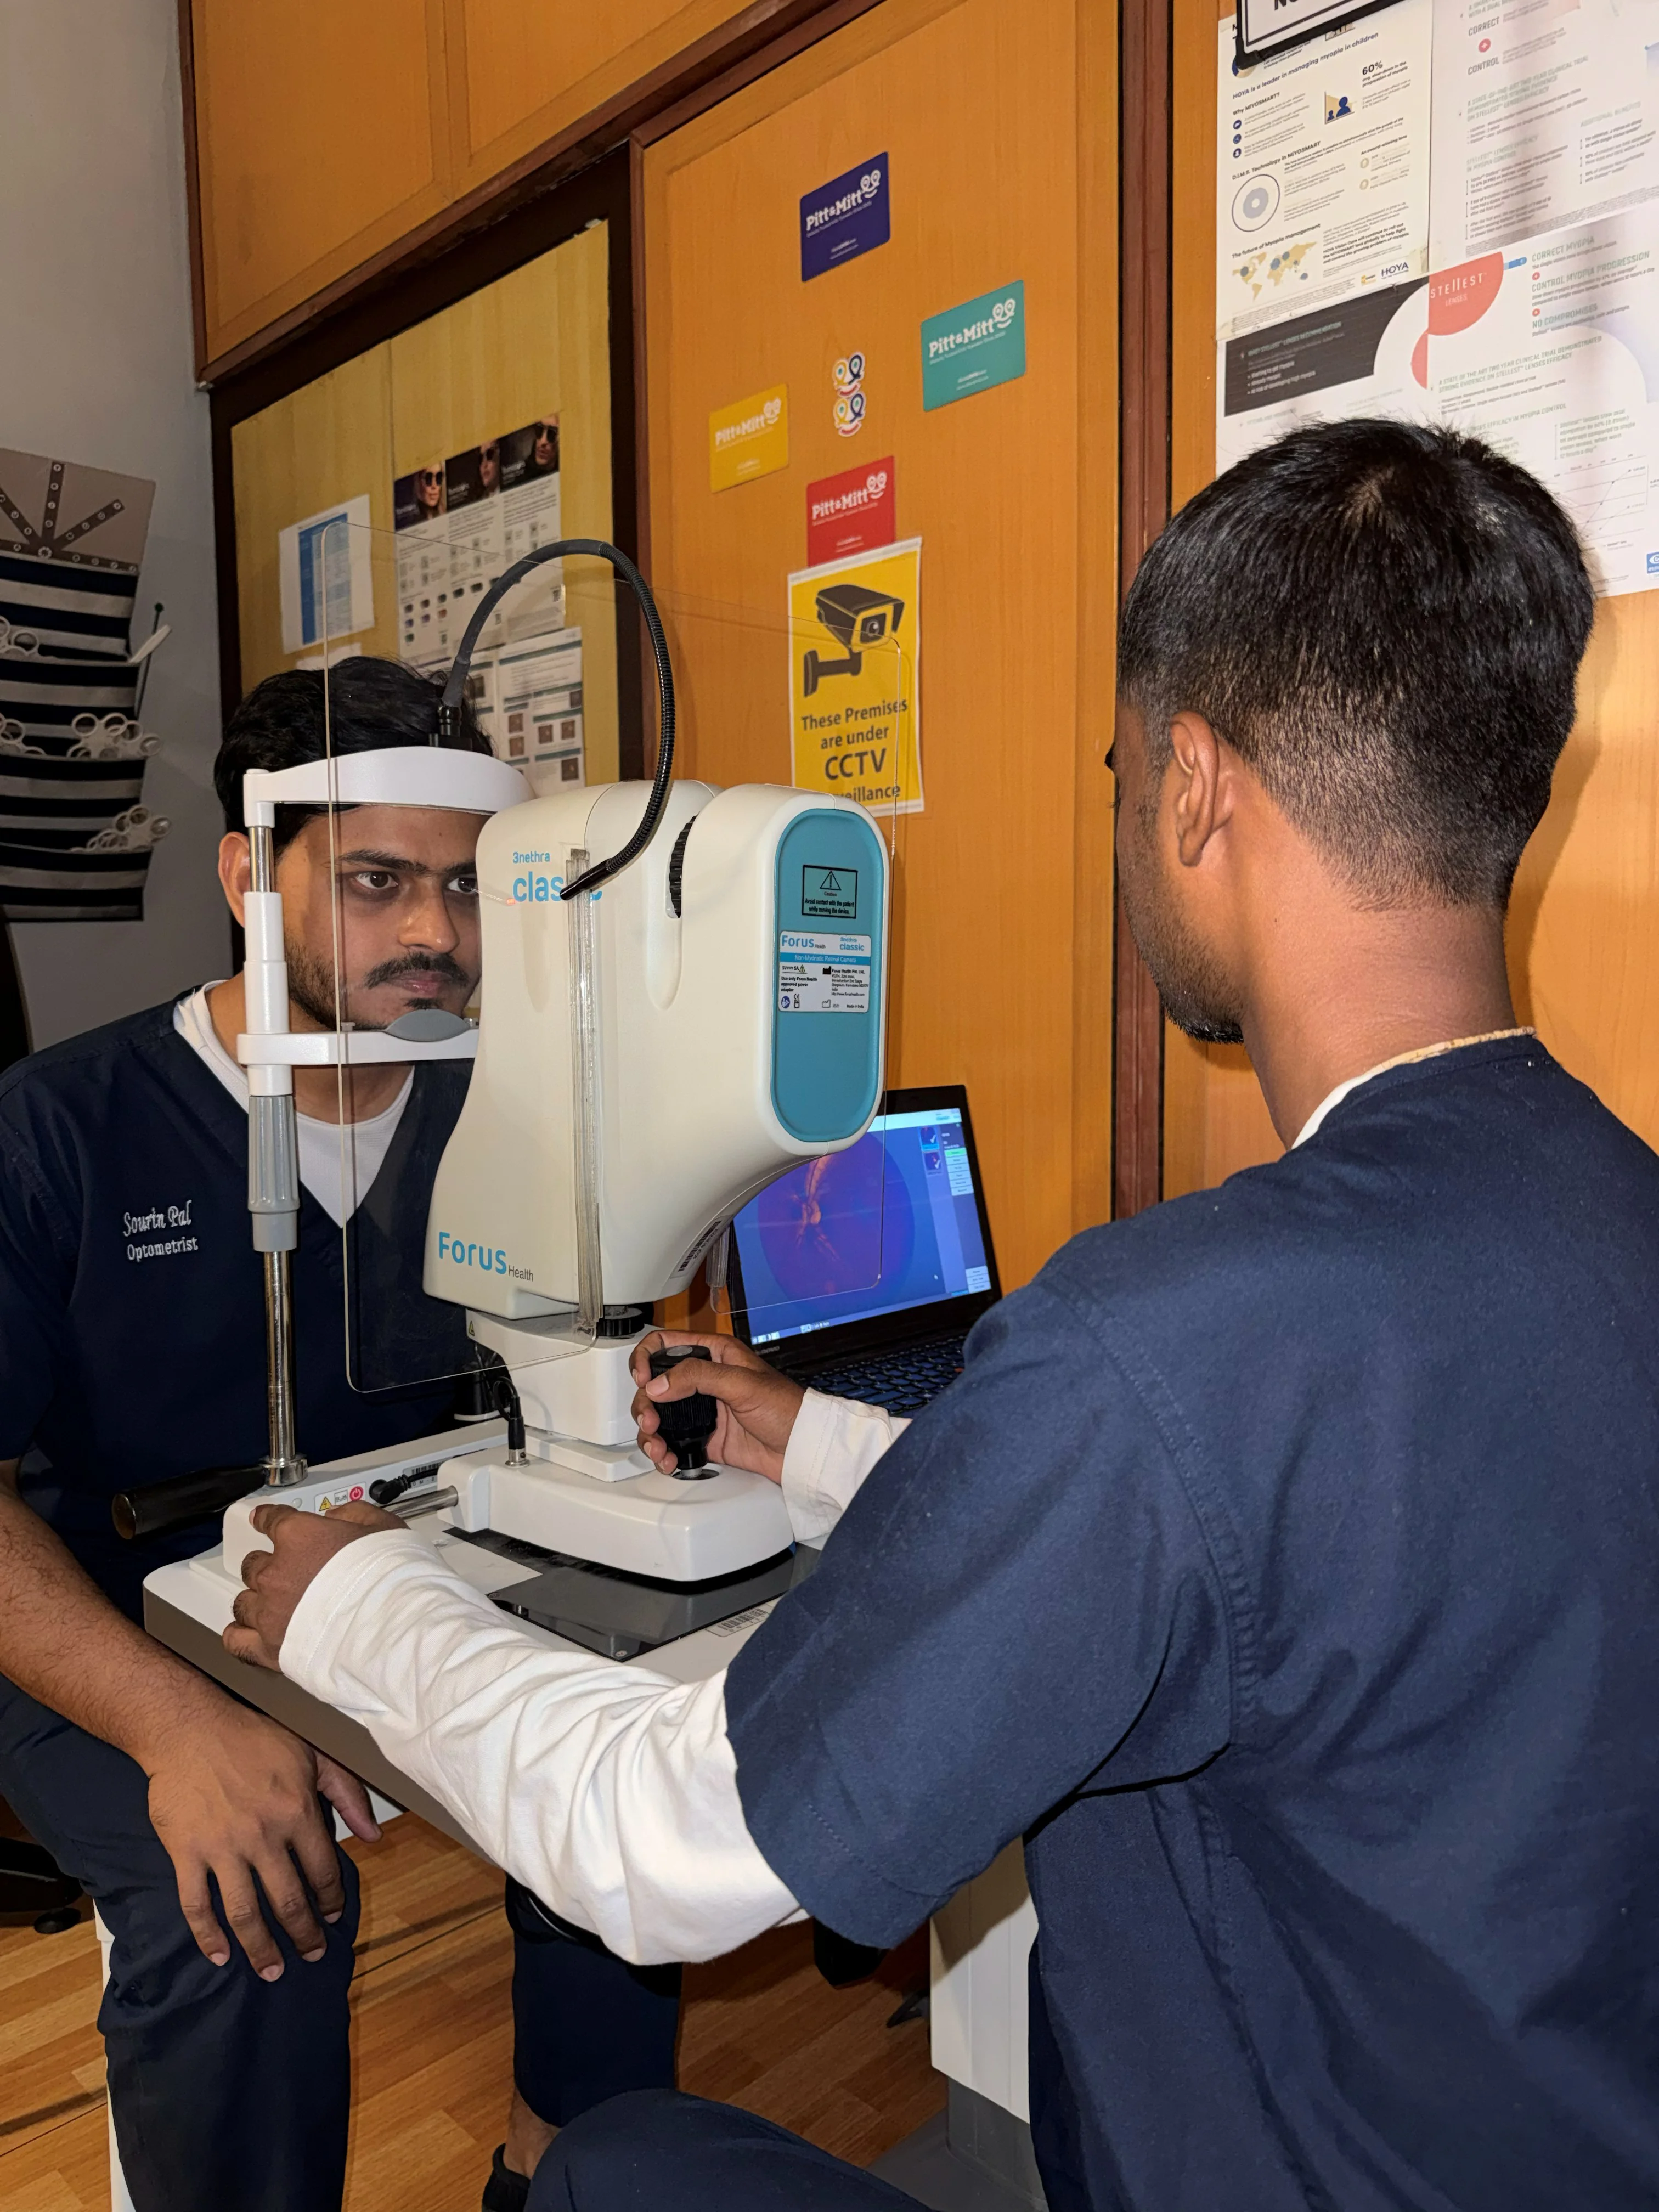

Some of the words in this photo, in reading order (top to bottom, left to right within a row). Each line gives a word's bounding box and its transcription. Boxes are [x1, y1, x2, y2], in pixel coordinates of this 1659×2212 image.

[1468, 16, 1499, 36] CORRECT
[1233, 88, 1249, 99] HOYA
[1262, 75, 1280, 87] leader
[1288, 58, 1318, 75] managing
[1319, 47, 1343, 61] myopia
[1352, 32, 1379, 47] children
[1362, 60, 1383, 75] 60%
[1468, 57, 1499, 75] CONTROL
[1251, 158, 1281, 172] Technology
[1288, 140, 1321, 158] MIYOSMART
[806, 189, 863, 232] Pitt&Mitt
[1242, 246, 1258, 255] future
[1265, 236, 1284, 247] Myopia
[1285, 223, 1321, 239] management
[1532, 244, 1564, 262] CORRECT
[1566, 234, 1595, 251] MYOPIA
[1381, 262, 1409, 276] HOYA
[1532, 275, 1565, 292] CONTROL
[1566, 264, 1595, 283] MYOPIA
[1595, 251, 1650, 274] PROGRESSION
[1445, 295, 1467, 307] LENSES
[1532, 318, 1542, 329] NO
[1544, 301, 1598, 325] COMPROMISES
[929, 318, 995, 358] Pitt&Mitt
[1443, 375, 1458, 385] STATE
[1515, 353, 1540, 365] CLINICAL
[1541, 349, 1556, 358] TRIAL
[1558, 335, 1602, 353] DEMONSTRATED
[1438, 382, 1459, 393] STRONG
[1460, 375, 1486, 387] EVIDENCE
[1541, 403, 1566, 414] CONTROL
[715, 415, 765, 446] Pitt&Mitt
[812, 488, 869, 520] Pitt&Mitt
[801, 711, 842, 732] These
[845, 698, 908, 723] Premises
[820, 735, 843, 751] are
[847, 725, 889, 746] under
[825, 748, 887, 781] CCTV
[512, 850, 550, 864] 3nethra
[781, 935, 814, 948] Forus
[839, 943, 865, 951] classic
[167, 1199, 192, 1227] Pal
[127, 1237, 199, 1263] Optometrist
[439, 1231, 507, 1274] Forus
[508, 1265, 534, 1282] Health
